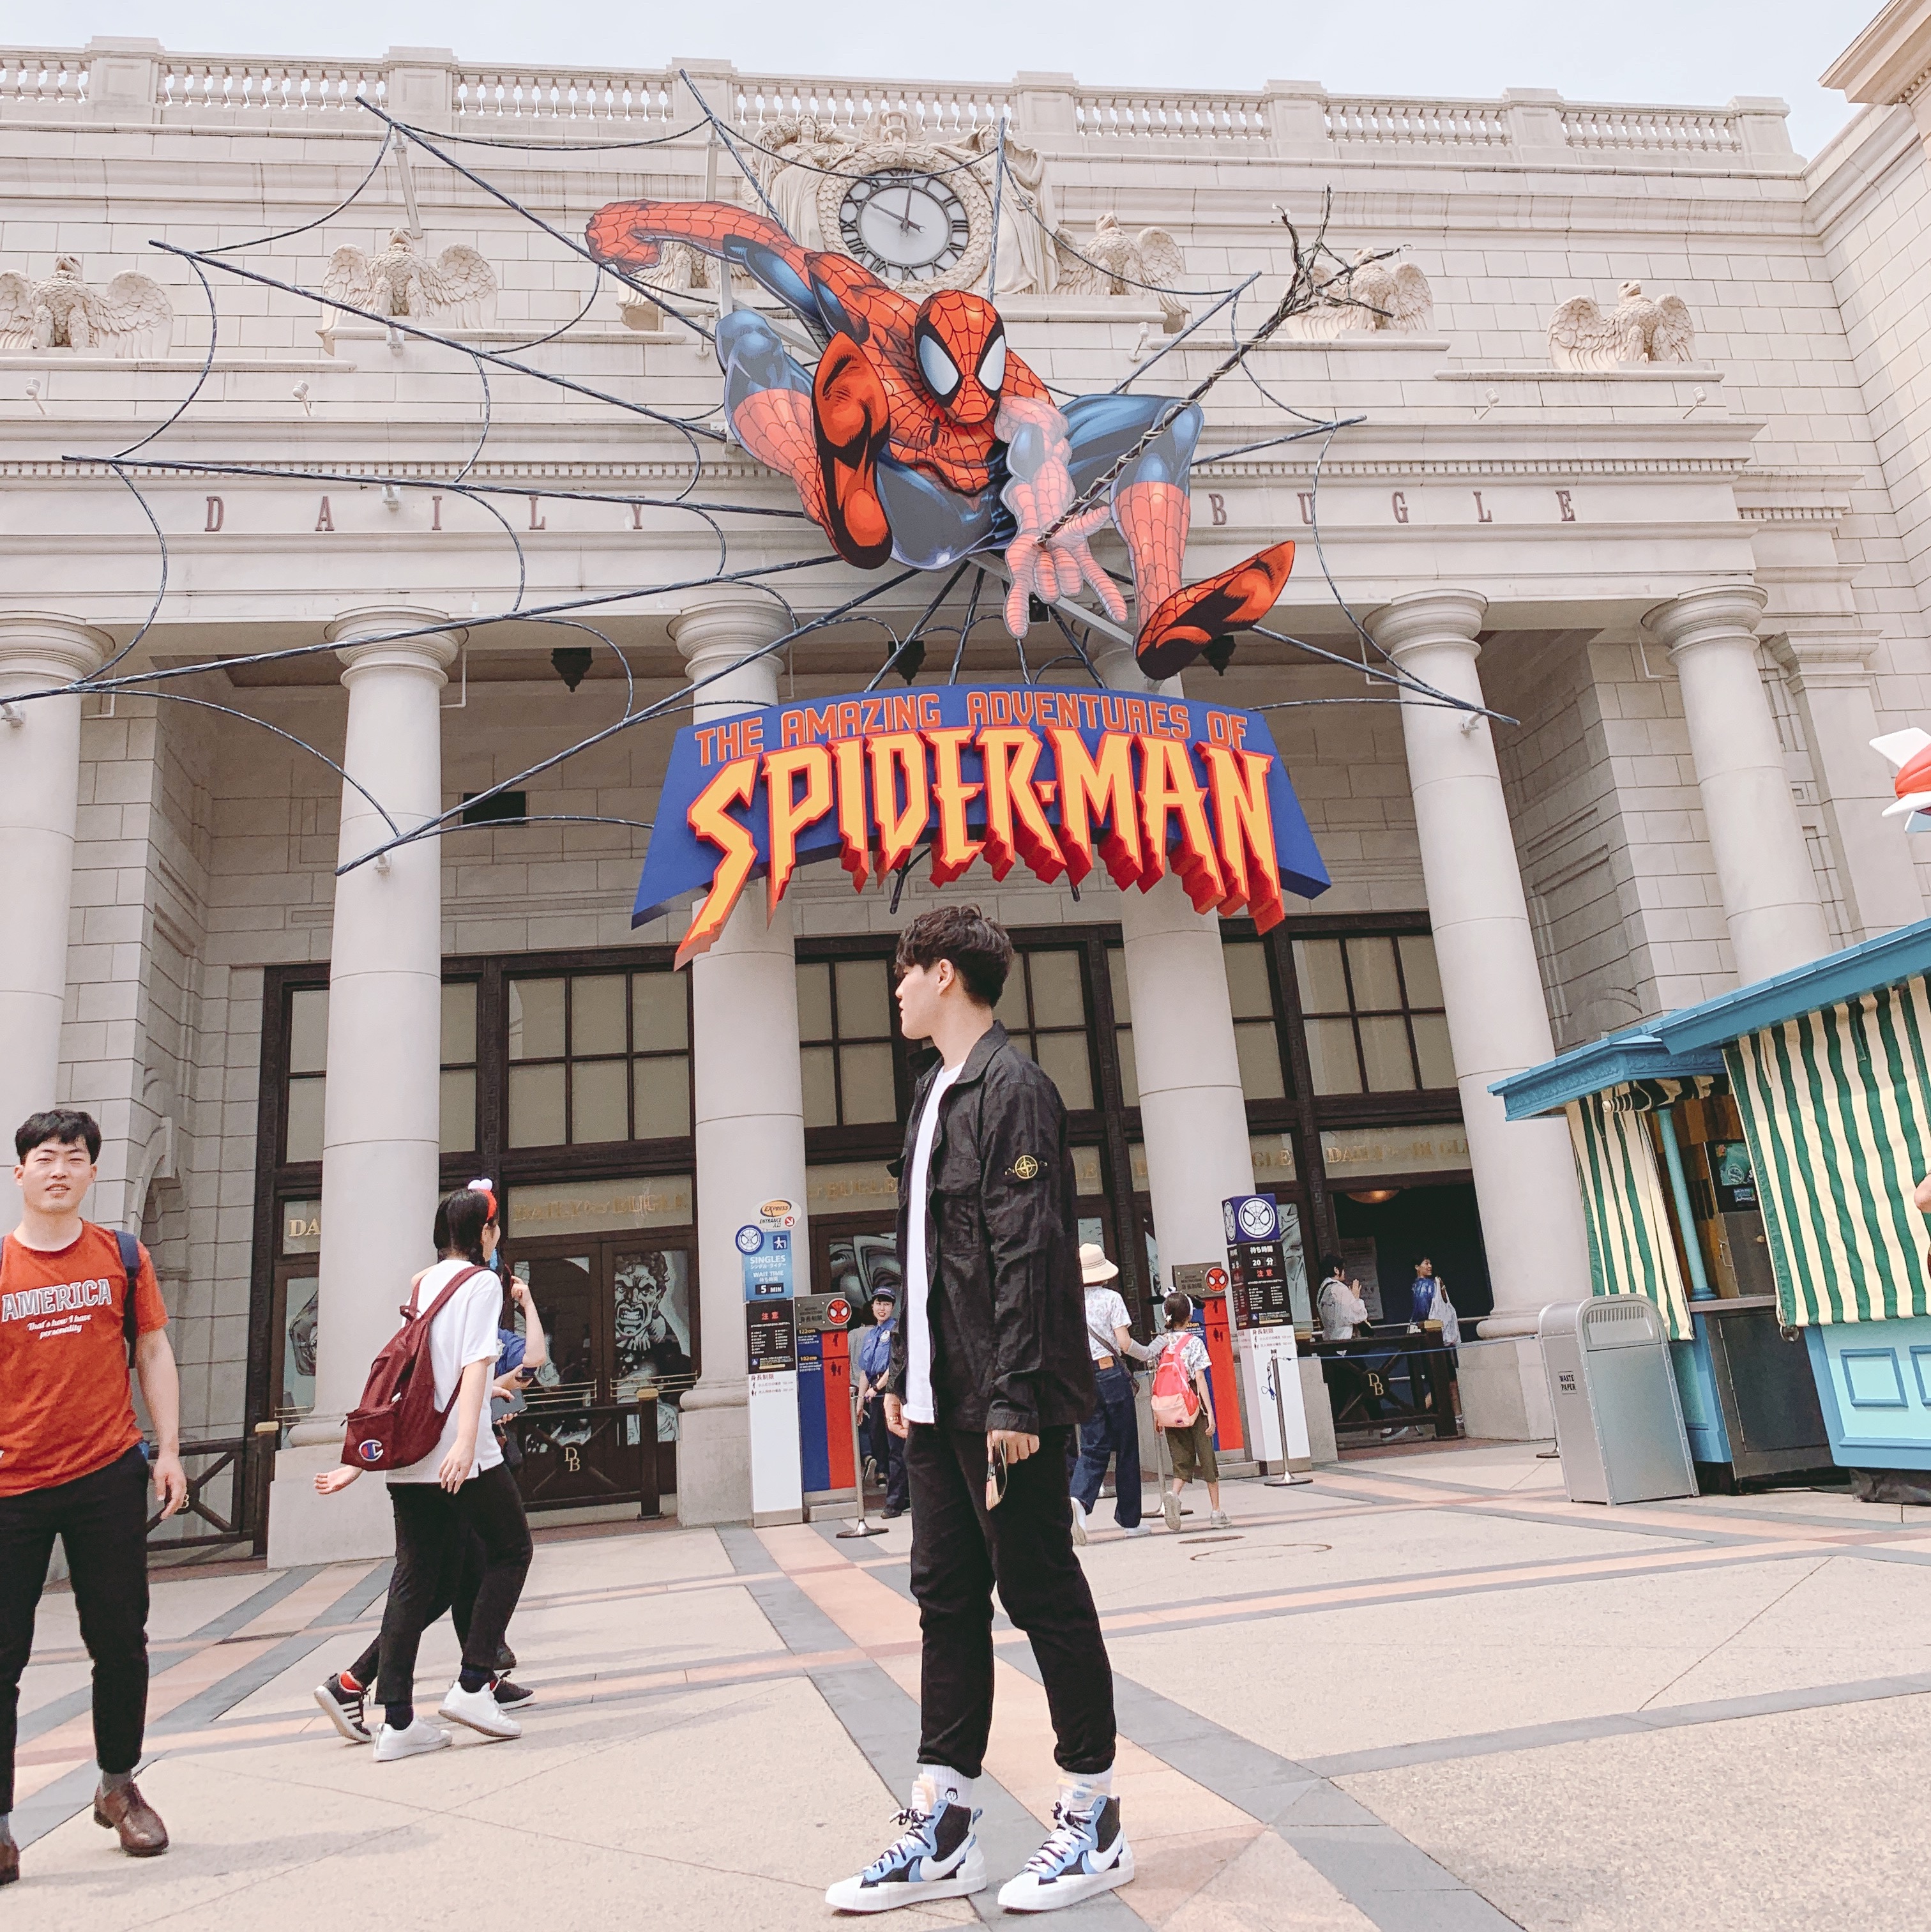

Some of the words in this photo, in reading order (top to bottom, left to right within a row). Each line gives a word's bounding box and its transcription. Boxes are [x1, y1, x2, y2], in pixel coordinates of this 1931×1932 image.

[1209, 489, 1577, 526] BUGLE
[695, 716, 764, 766] THE
[780, 693, 941, 748] AMAZING
[966, 690, 1192, 739] ADVENTURES
[1206, 711, 1248, 749] OF
[674, 726, 1285, 971] SPIDER-MAN
[750, 1255, 786, 1265] SINGLES
[2, 1279, 112, 1323] AMERICA
[761, 1284, 767, 1294] 5
[39, 1323, 83, 1340] personality
[52, 1317, 68, 1327] how
[74, 1314, 92, 1322] have
